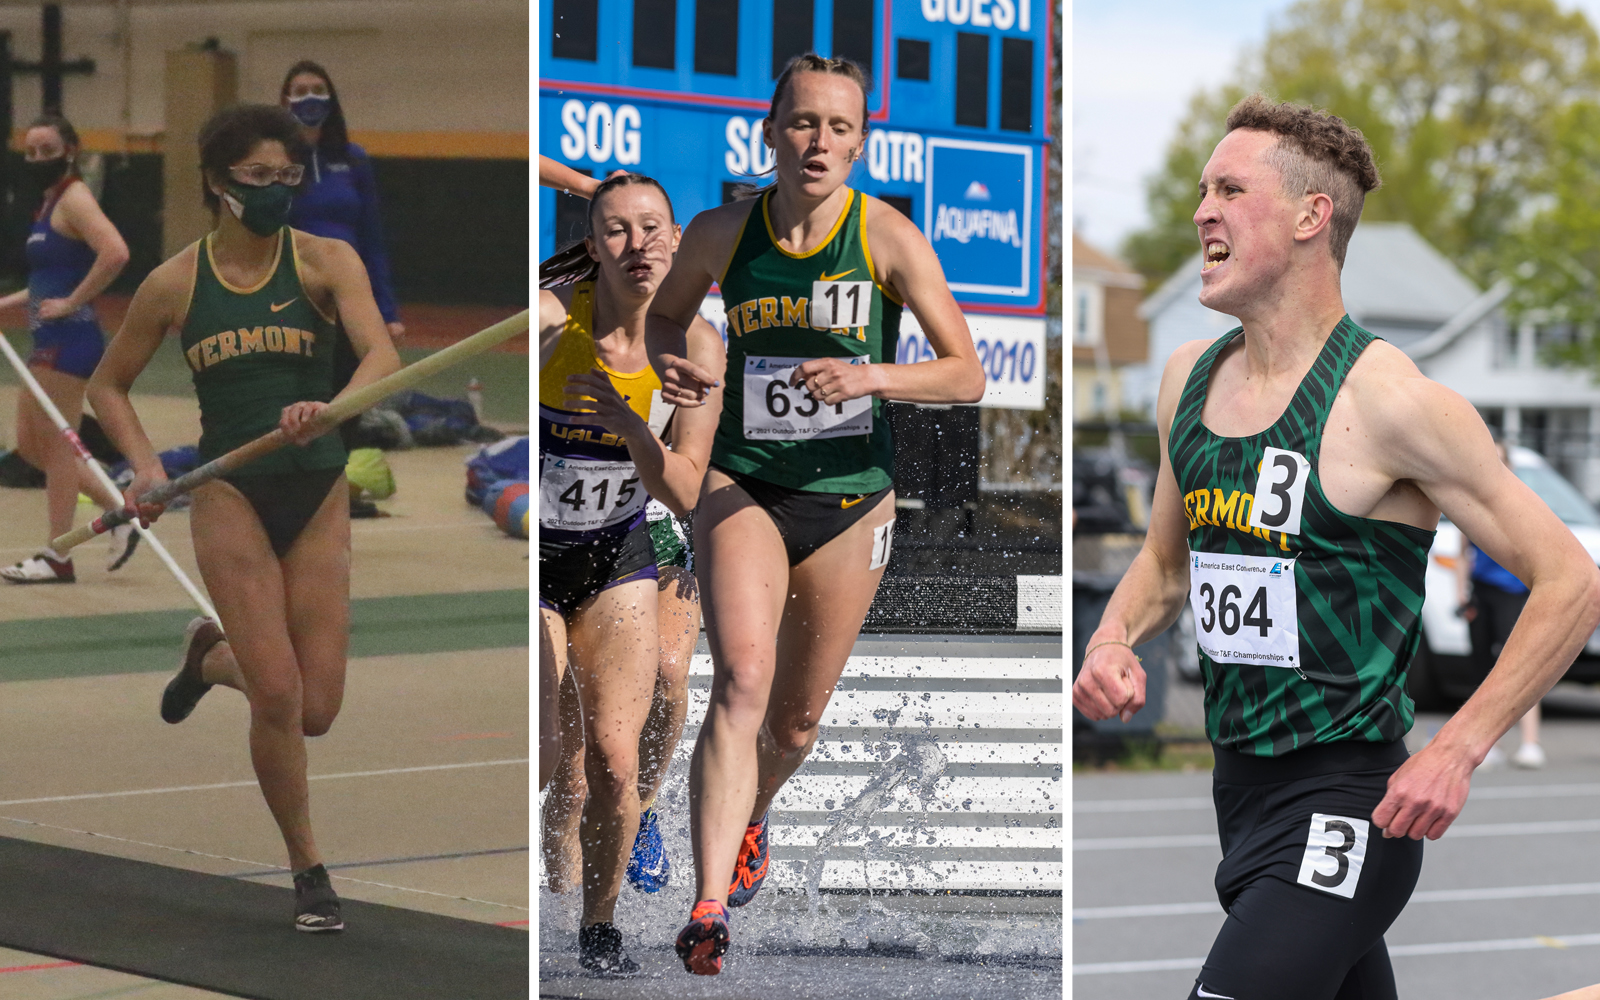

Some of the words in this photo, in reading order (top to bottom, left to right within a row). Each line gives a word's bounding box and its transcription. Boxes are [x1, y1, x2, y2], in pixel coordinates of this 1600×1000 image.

[560, 99, 641, 165] SOG
[725, 116, 777, 178] SO
[868, 128, 924, 183] QTR
[933, 203, 1022, 248] AQUAFINA
[728, 296, 866, 342] VERM
[824, 284, 860, 325] 11
[187, 326, 316, 372] VERMONT
[977, 339, 1036, 382] 2010
[551, 423, 628, 448] UALBA
[559, 477, 640, 511] 415
[1260, 454, 1298, 527] 3
[1184, 488, 1292, 552] ERMO
[1200, 562, 1220, 570] America
[1221, 563, 1235, 571] East
[1200, 582, 1273, 637] 364
[1233, 651, 1285, 661] Championships
[1311, 820, 1355, 888] 3
